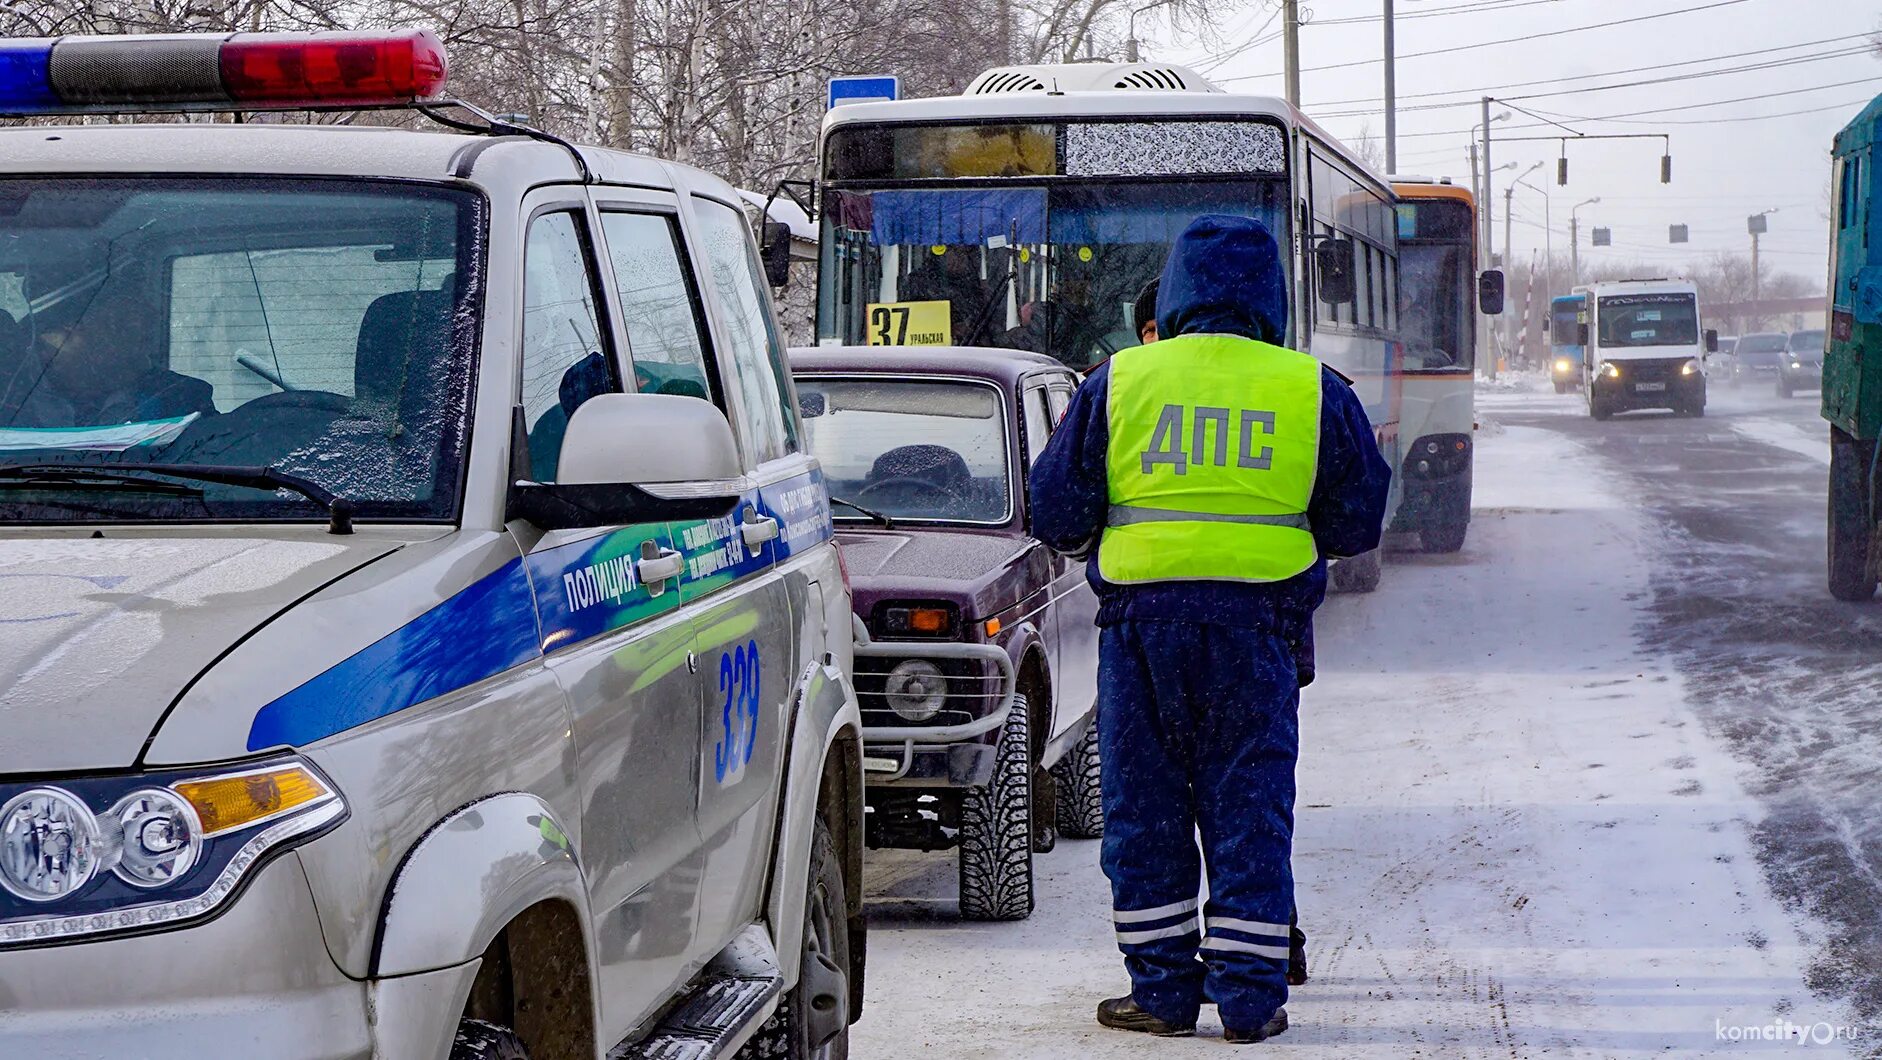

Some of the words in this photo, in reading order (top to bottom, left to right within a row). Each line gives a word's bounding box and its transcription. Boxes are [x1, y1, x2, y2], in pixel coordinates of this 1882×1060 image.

[872, 307, 910, 346] 37
[910, 332, 944, 345] УРАЛЬСКАЯ
[1140, 403, 1276, 476] ДПС
[563, 554, 637, 613] ПОЛИЦИЯ
[715, 639, 760, 783] 339
